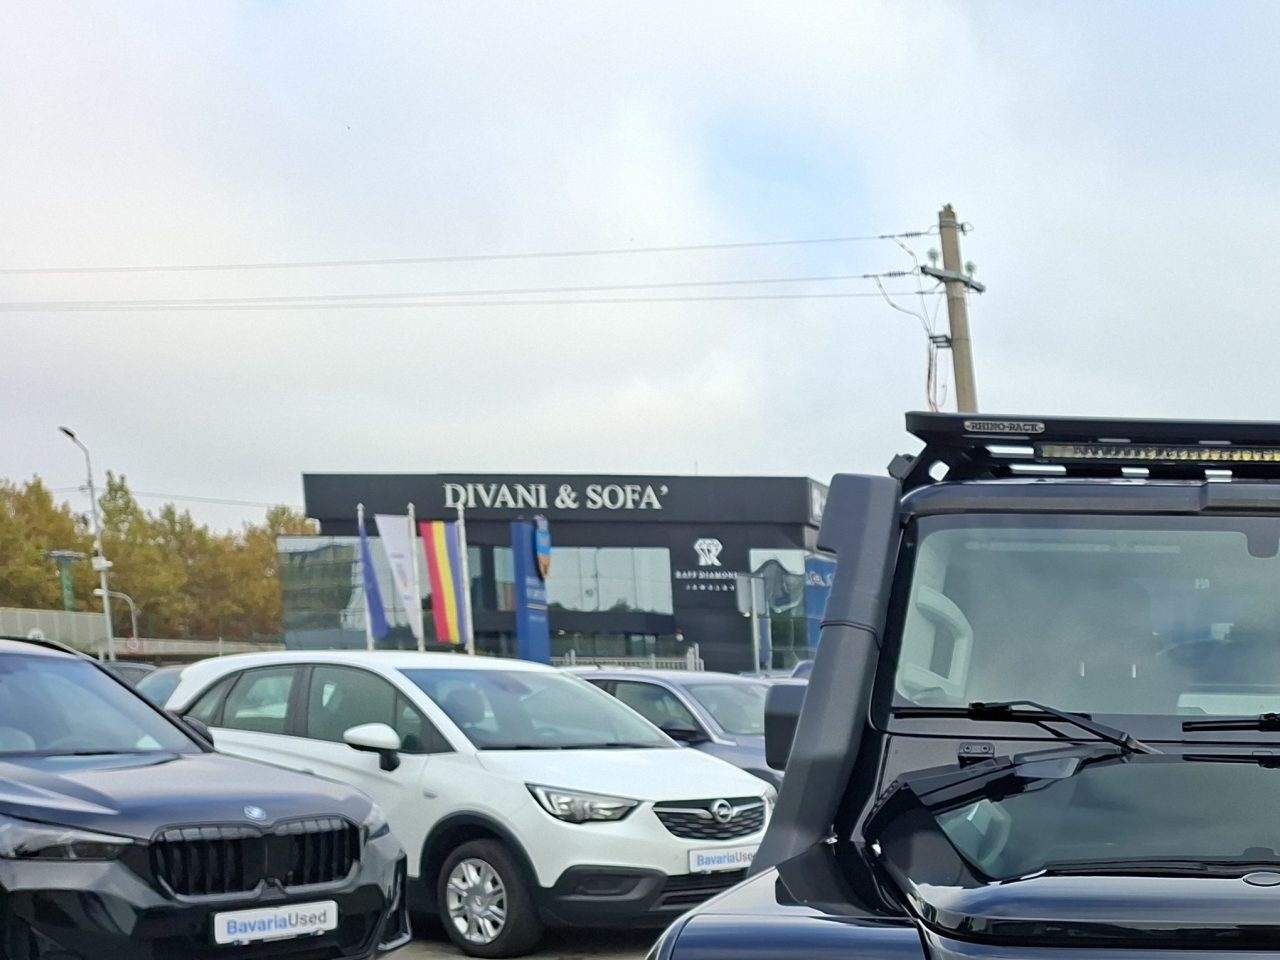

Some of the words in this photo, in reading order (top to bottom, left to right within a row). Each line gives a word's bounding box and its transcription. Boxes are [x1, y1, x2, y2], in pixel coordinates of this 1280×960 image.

[971, 422, 1038, 432] RHINO-RACK
[443, 483, 548, 509] DIVANI
[555, 484, 579, 509] &
[696, 851, 754, 866] BavariaUse
[226, 910, 327, 935] BavariaUsed
